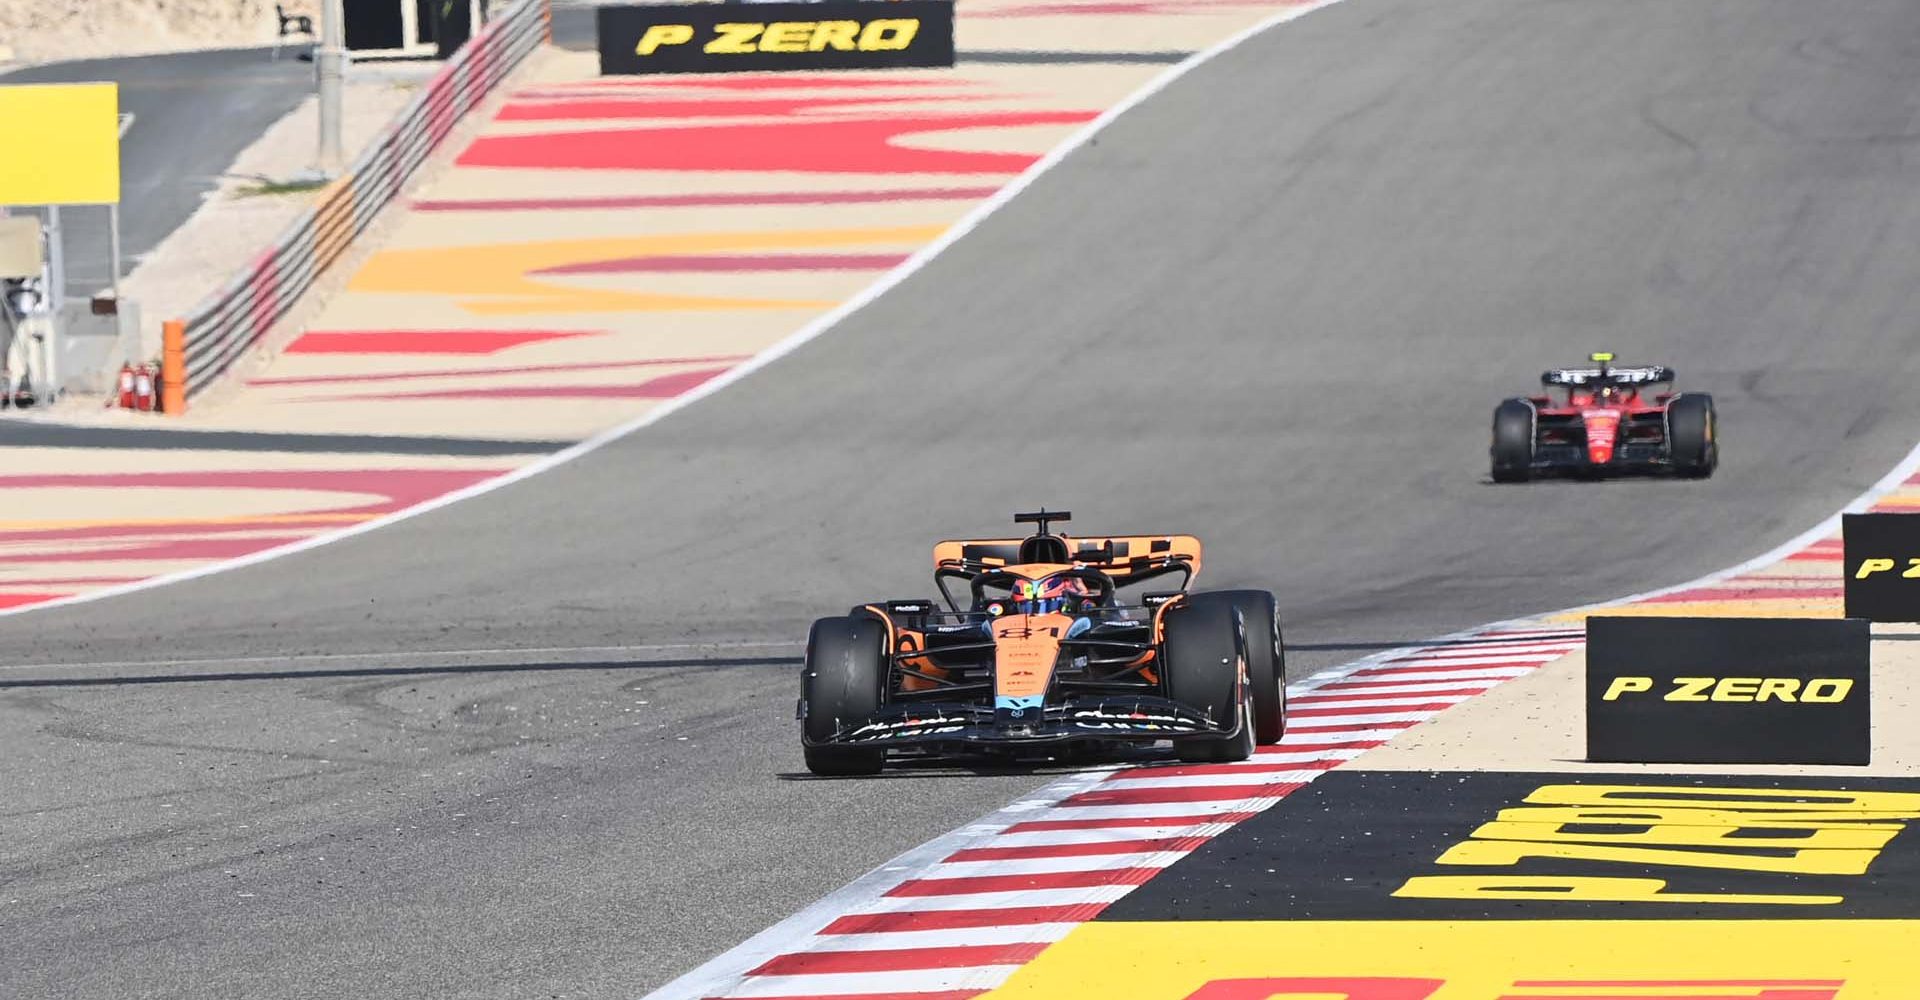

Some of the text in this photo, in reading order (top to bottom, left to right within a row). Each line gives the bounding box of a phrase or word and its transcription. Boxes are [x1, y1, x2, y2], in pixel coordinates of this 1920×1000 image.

[636, 18, 921, 56] P ZERO
[1855, 558, 1895, 579] P
[1602, 677, 1854, 703] P ZERO
